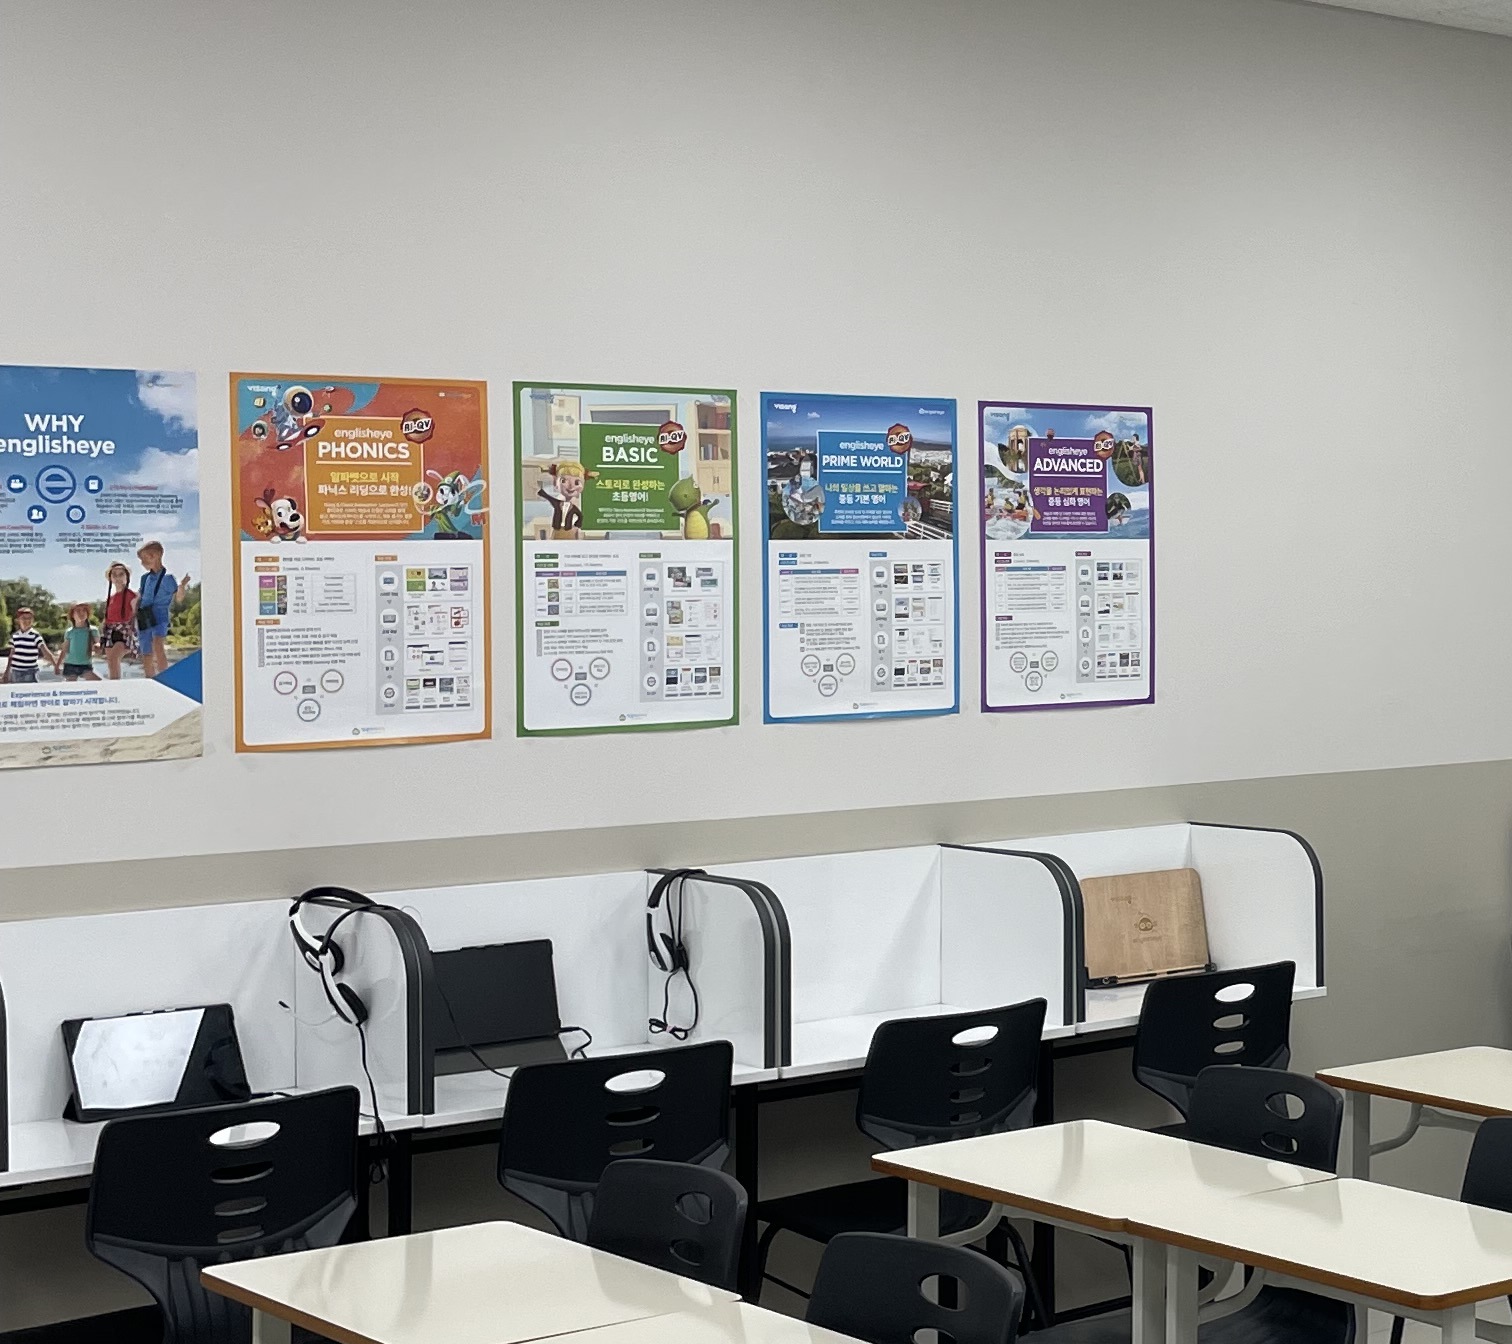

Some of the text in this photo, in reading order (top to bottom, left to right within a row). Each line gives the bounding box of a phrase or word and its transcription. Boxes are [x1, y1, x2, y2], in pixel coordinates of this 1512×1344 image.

[24, 413, 85, 433] WHY
[334, 428, 393, 440] englisheye
[604, 433, 655, 445] englisheye
[0, 435, 116, 457] englisheye
[318, 441, 410, 459] PHONICS
[839, 441, 885, 452] englisheye
[1048, 446, 1088, 457] englisheye
[602, 447, 658, 463] BASIC
[822, 455, 903, 468] PRIME WORLD
[1033, 457, 1104, 473] ADVANCED
[330, 472, 400, 483] 알파벳으로 시작
[318, 484, 347, 495] 파닉스
[350, 484, 388, 496] 리딩으로
[596, 479, 630, 490] 스토리로
